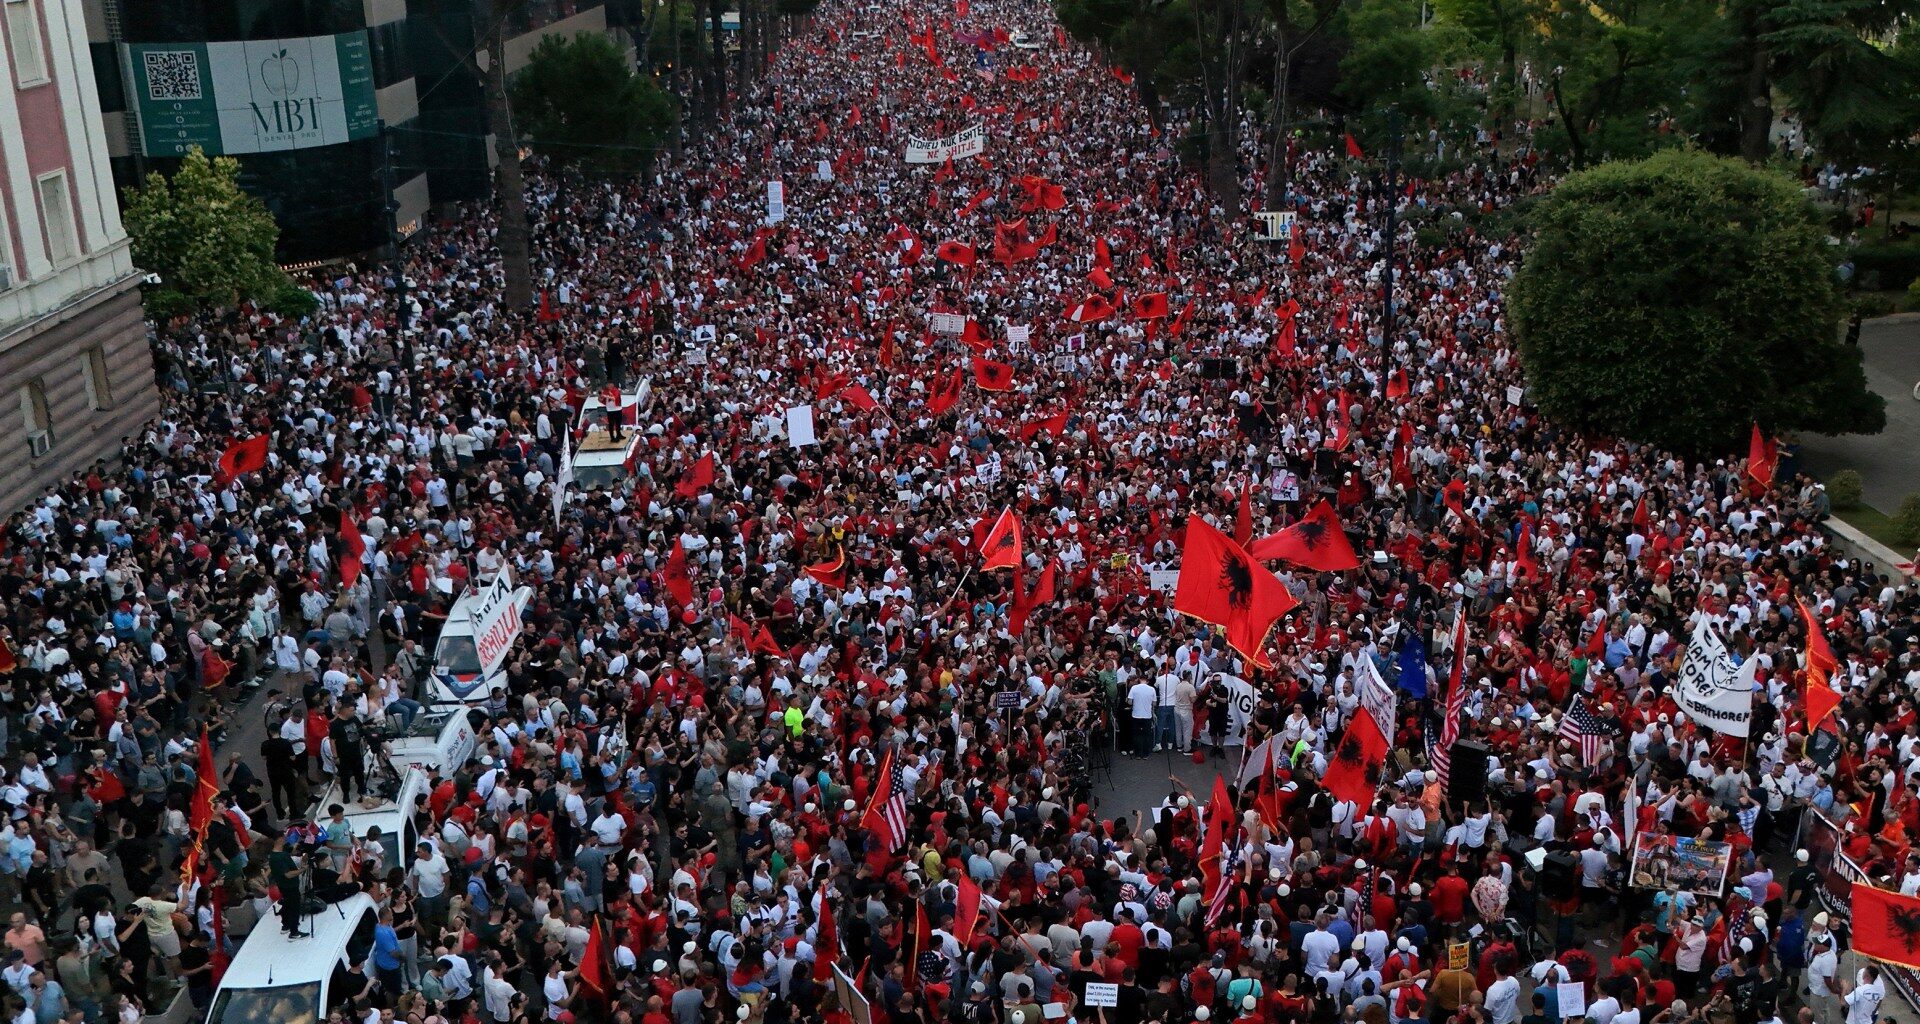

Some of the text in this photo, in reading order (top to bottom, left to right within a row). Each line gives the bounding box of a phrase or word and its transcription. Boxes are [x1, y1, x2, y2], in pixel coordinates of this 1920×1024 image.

[249, 97, 322, 136] MBT
[264, 134, 296, 142] DENTAL
[908, 125, 982, 150] ATDHEU NUK ESHTE
[927, 140, 976, 159] NE SHITJE
